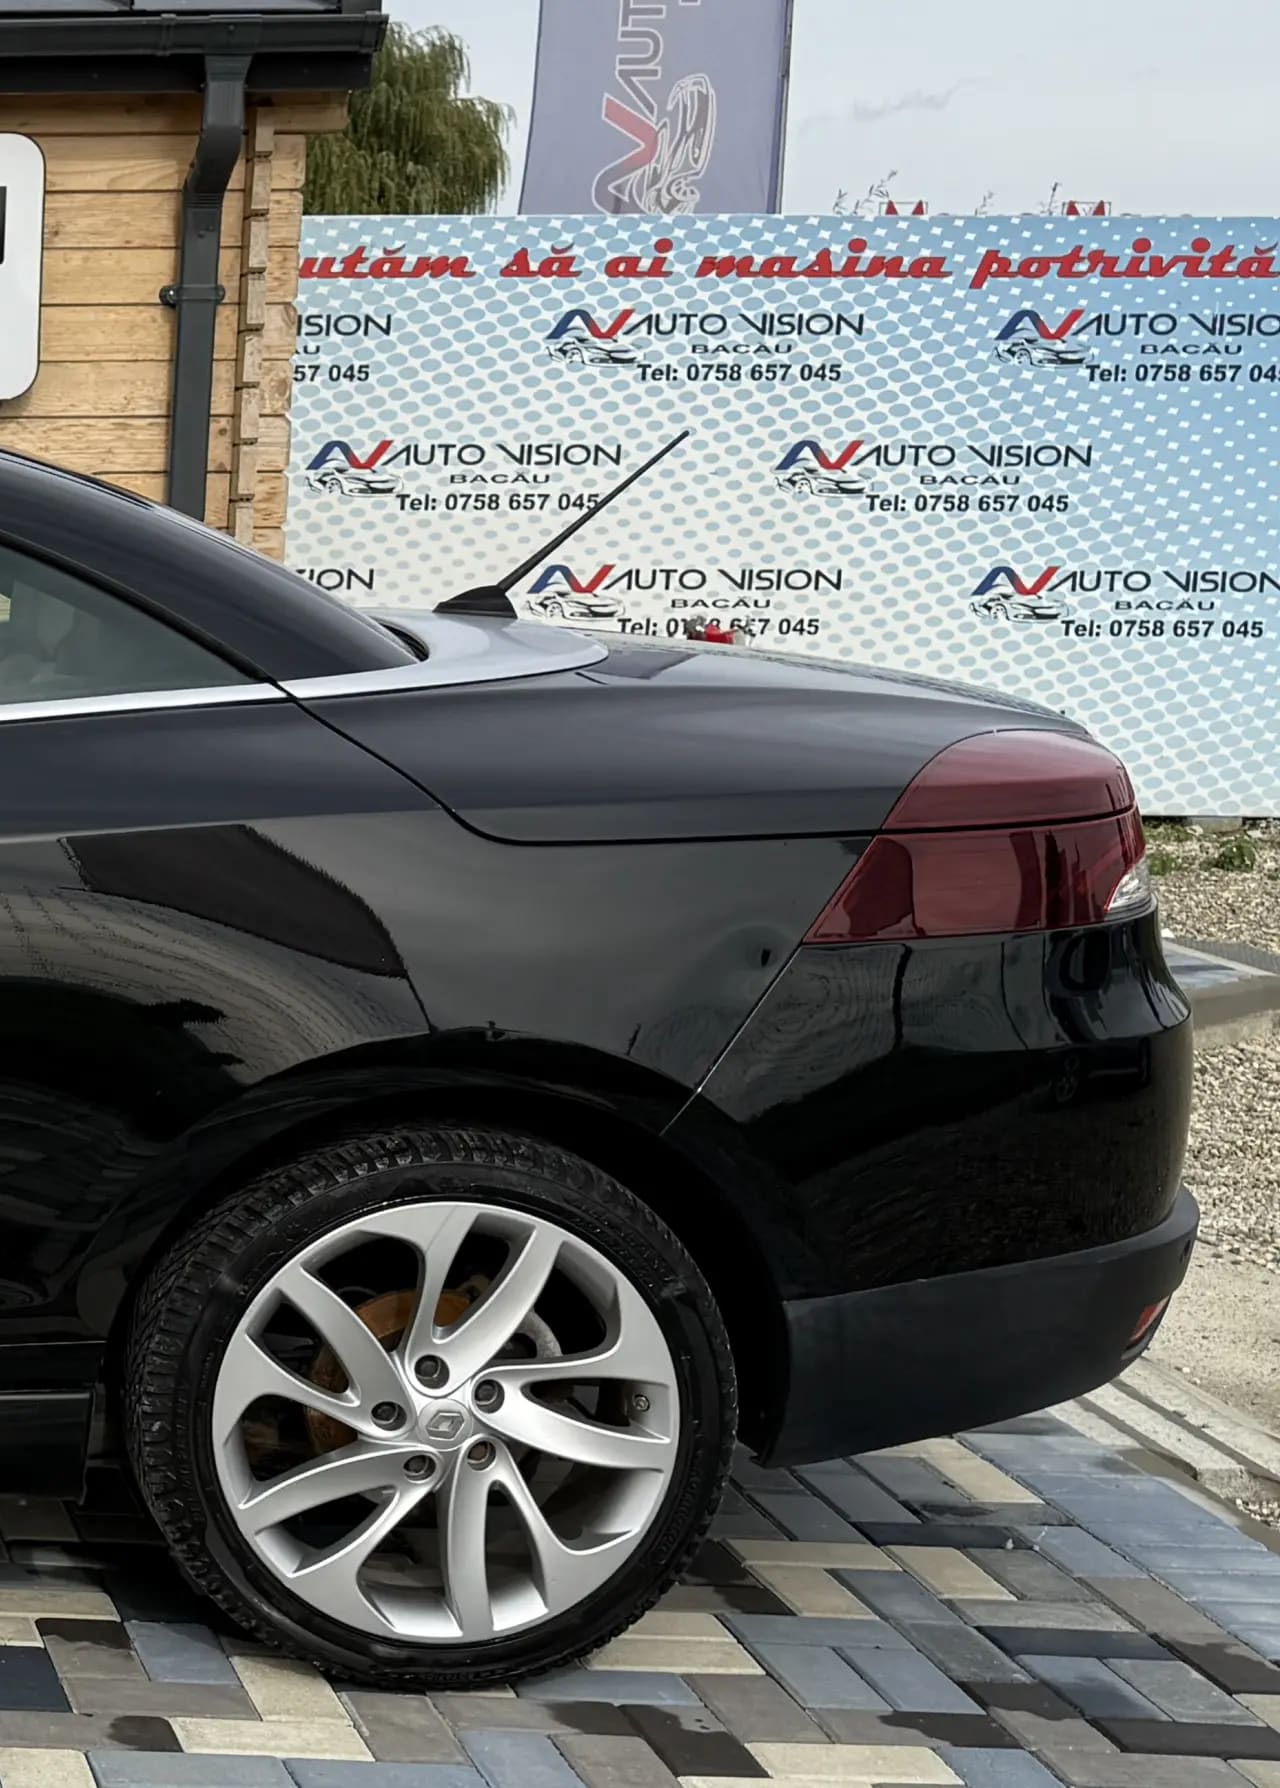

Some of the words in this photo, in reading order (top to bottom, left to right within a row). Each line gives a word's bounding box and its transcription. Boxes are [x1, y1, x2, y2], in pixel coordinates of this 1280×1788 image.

[500, 243, 582, 279] să
[605, 238, 673, 279] ai
[695, 238, 952, 279] masina
[968, 237, 1280, 289] potrivită
[622, 313, 728, 337] AUTO
[738, 313, 865, 337] VISION
[1072, 313, 1178, 337] AUTO
[328, 363, 370, 382] 045
[640, 363, 678, 382] Tel:
[686, 363, 742, 382] 0758
[750, 363, 792, 382] 657
[799, 363, 842, 382] 045
[1088, 363, 1127, 383] Tel:
[1134, 363, 1192, 382] 0758
[1199, 364, 1243, 383] 657
[381, 444, 486, 466] AUTO
[495, 443, 622, 466] VISION
[851, 445, 956, 467] AUTO
[967, 444, 1093, 468] VISION
[397, 493, 437, 511] Tel:
[445, 493, 500, 511] 0758
[508, 493, 551, 511] 657
[866, 494, 907, 512] Tel:
[914, 494, 970, 512] 0758
[978, 494, 1020, 513] 657
[1027, 494, 1069, 513] 045
[602, 569, 707, 591] AUTO
[717, 568, 842, 591] VISION
[1047, 571, 1152, 593] AUTO
[778, 618, 820, 636] 045
[1060, 619, 1102, 637] Tel:
[1109, 619, 1165, 637] 0758
[1172, 619, 1215, 638] 657
[1222, 620, 1264, 638] 045
